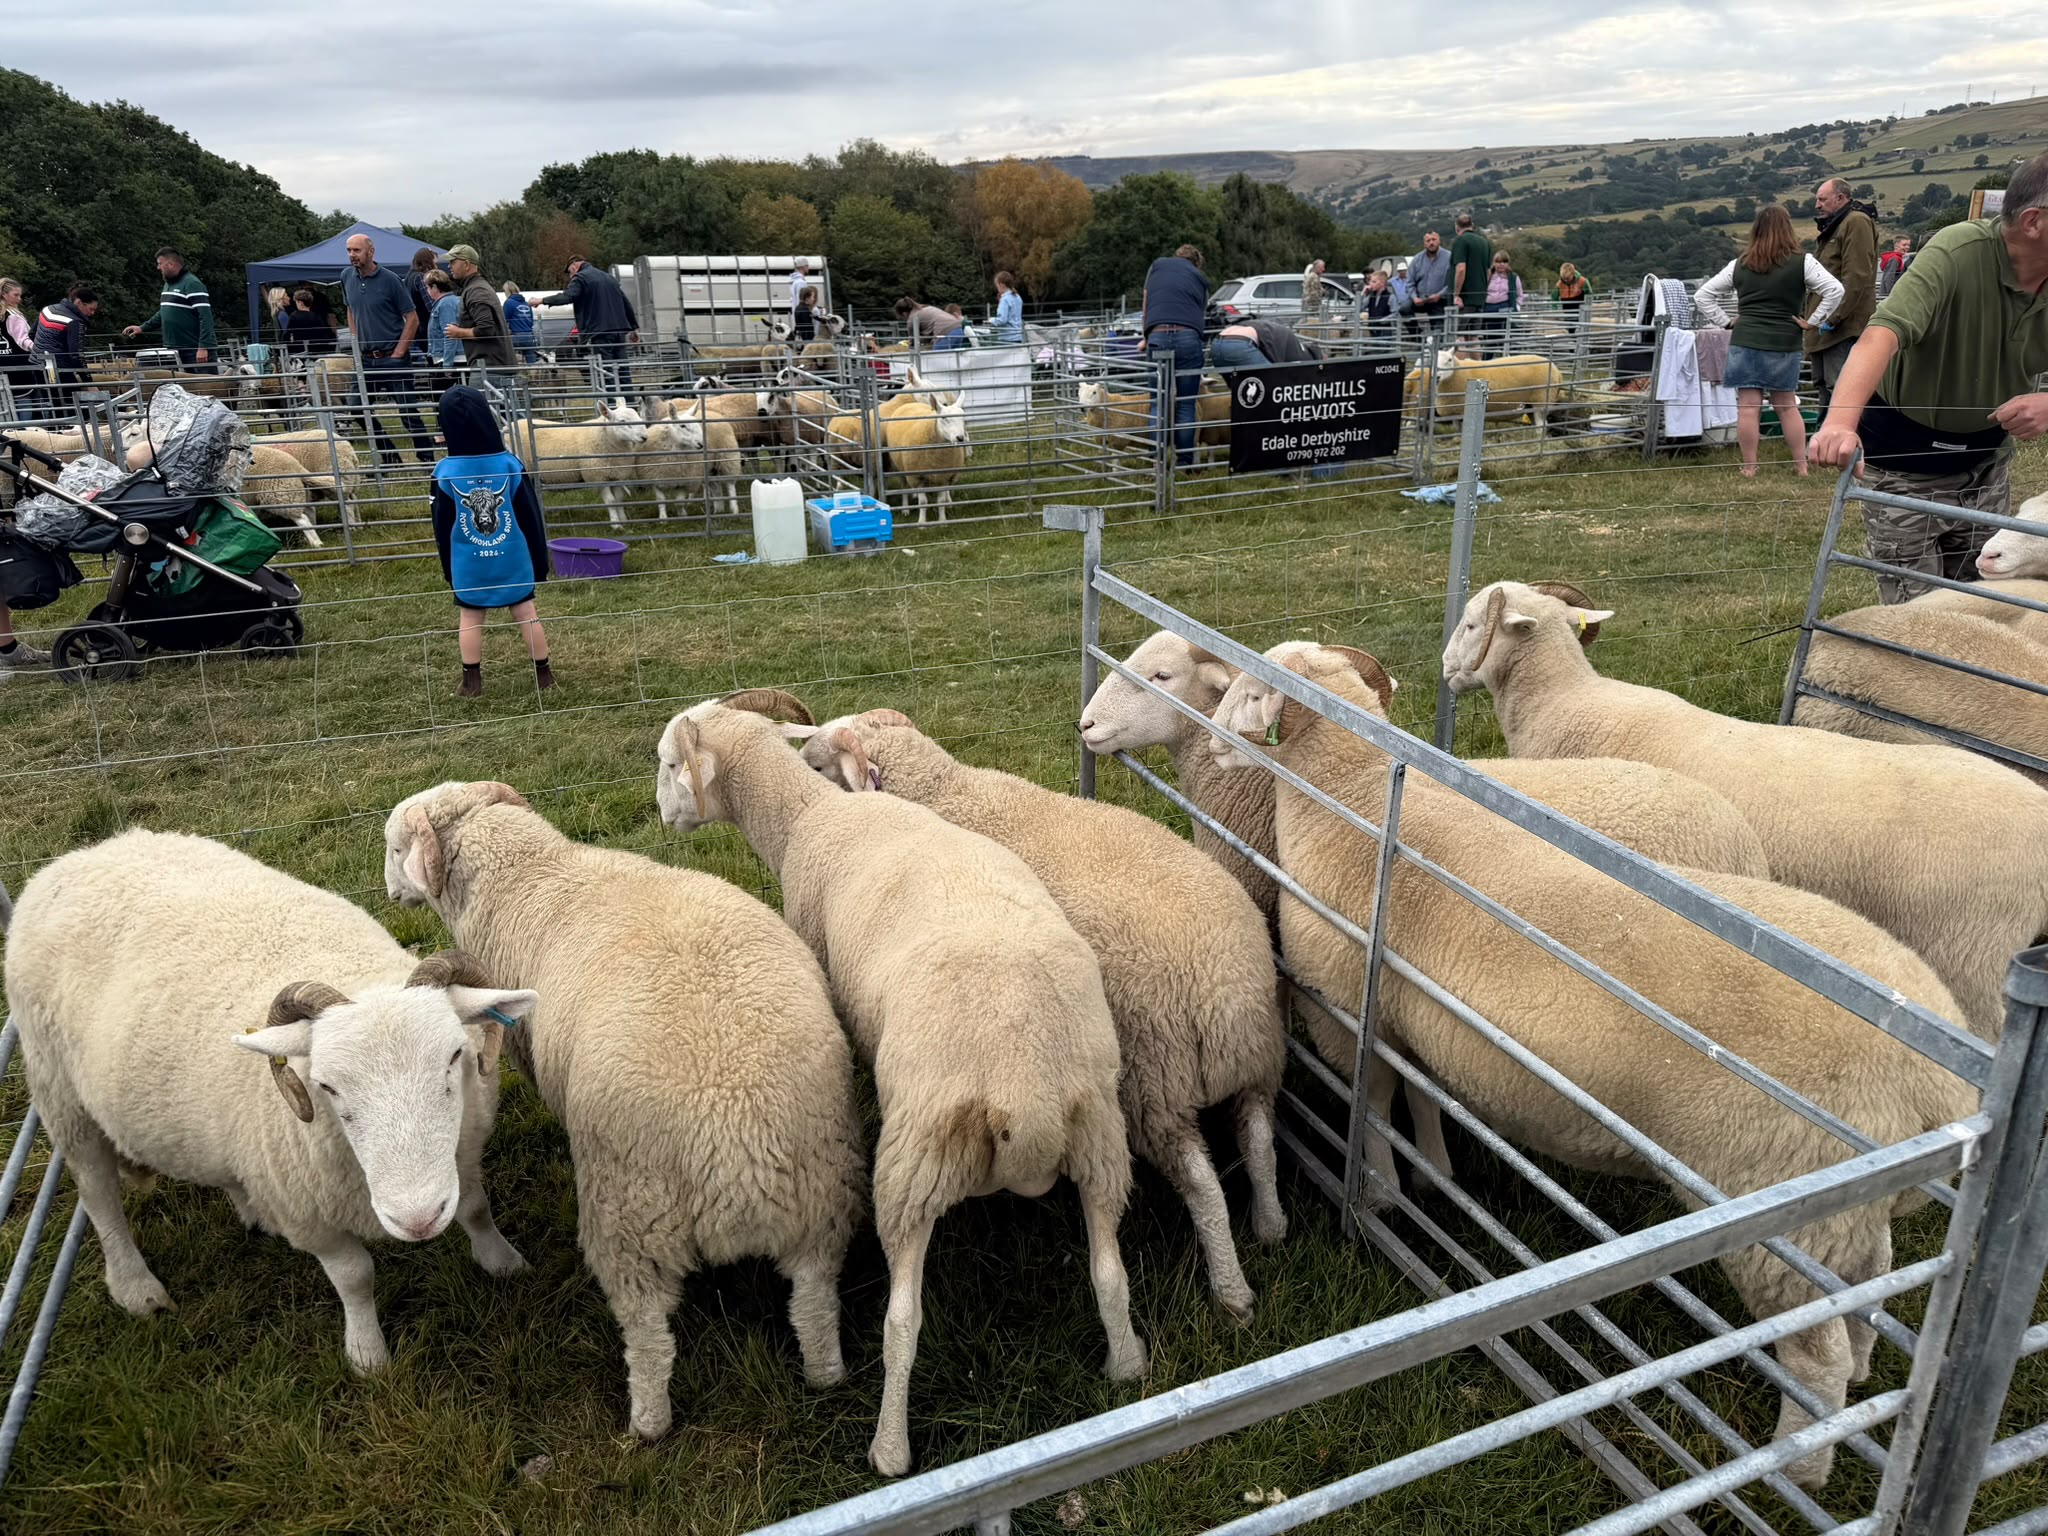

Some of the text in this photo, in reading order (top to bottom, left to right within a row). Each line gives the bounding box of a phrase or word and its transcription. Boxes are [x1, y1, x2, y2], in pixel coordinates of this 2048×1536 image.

[1272, 379, 1366, 403] GREENHILLS
[1280, 401, 1356, 424] CHEVIOTS
[1262, 427, 1371, 451] Edale Derbyshire
[1287, 445, 1346, 461] 07790 972 202
[459, 512, 471, 537] ROYAL
[469, 533, 507, 547] HIGHLAND
